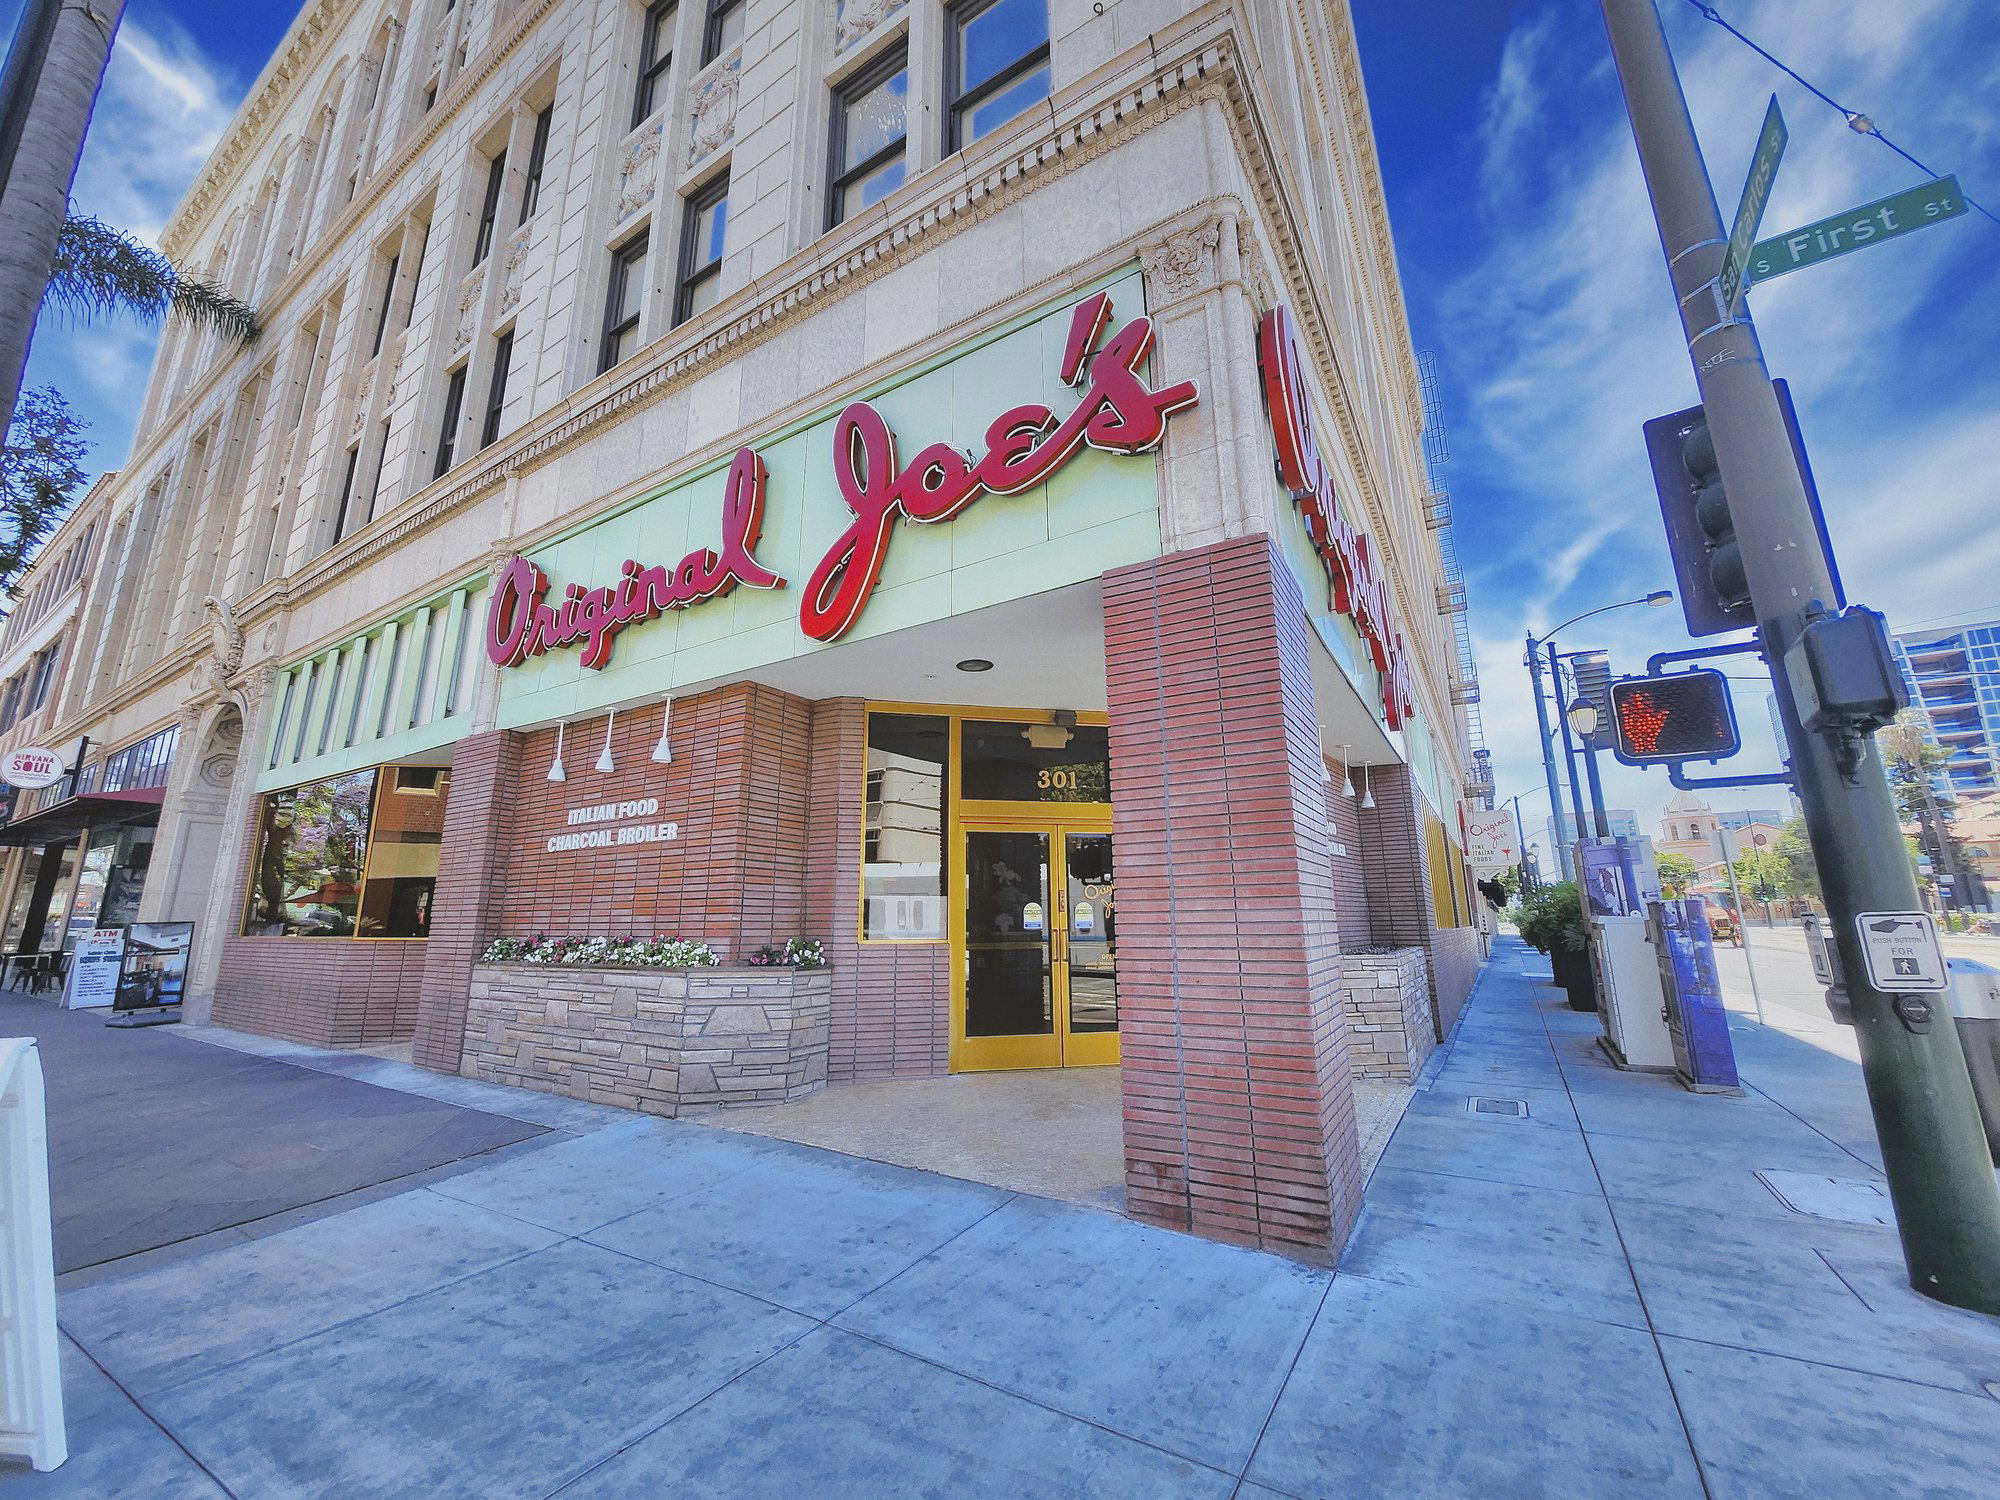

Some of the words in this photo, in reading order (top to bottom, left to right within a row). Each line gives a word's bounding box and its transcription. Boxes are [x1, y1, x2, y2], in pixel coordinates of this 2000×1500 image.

[1720, 251, 1742, 302] San
[1736, 153, 1771, 251] Carlos
[1769, 127, 1783, 154] St
[1755, 259, 1771, 274] S
[1785, 206, 1899, 263] First
[1923, 197, 1954, 217] St
[485, 447, 789, 672] Original
[799, 290, 1201, 645] Joe's
[12, 760, 51, 774] SOUL
[15, 754, 54, 763] NIRVANA
[1037, 769, 1078, 790] 301
[567, 803, 616, 826] ITALIAN
[618, 797, 660, 819] FOOD
[1469, 812, 1511, 837] Original
[547, 829, 615, 853] CHARCOAL
[617, 822, 679, 846] BROILER
[93, 930, 119, 938] ATM
[1891, 947, 1914, 955] FOR
